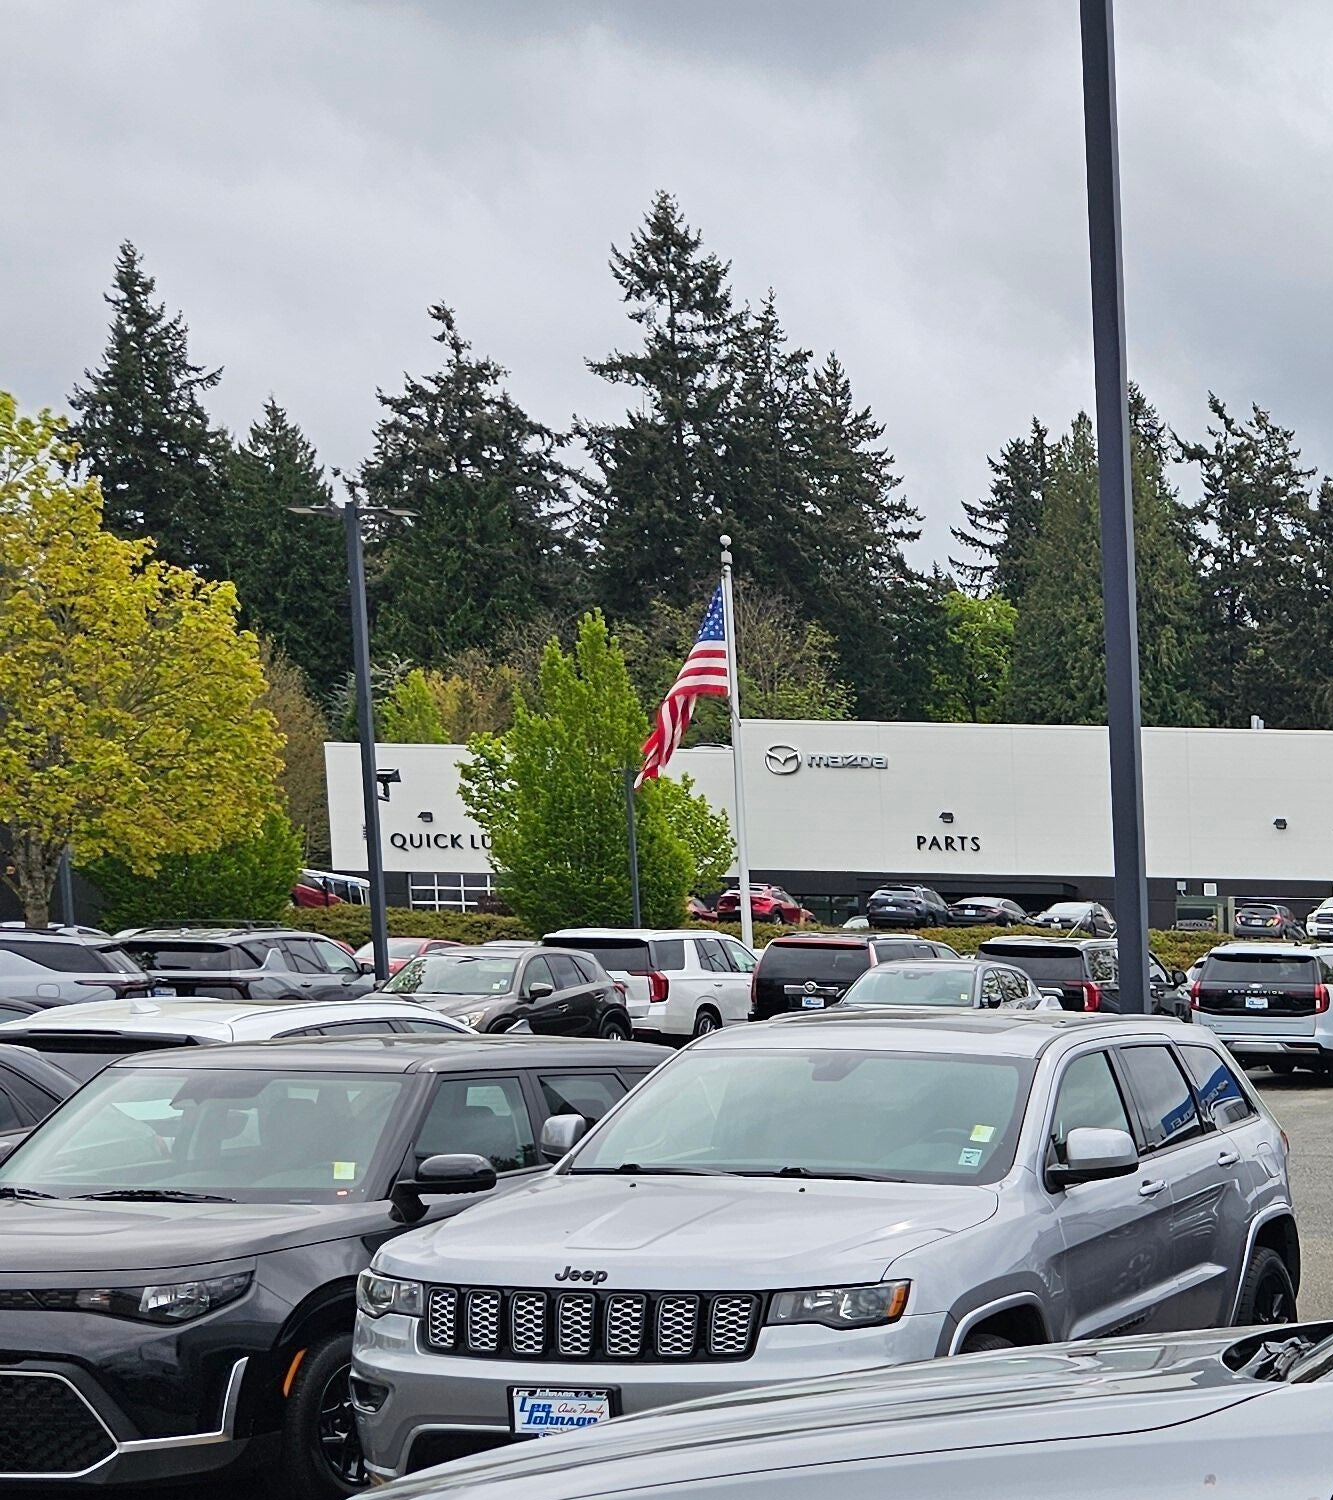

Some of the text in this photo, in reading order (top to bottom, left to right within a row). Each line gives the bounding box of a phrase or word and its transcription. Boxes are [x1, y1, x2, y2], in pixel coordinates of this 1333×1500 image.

[390, 832, 494, 852] QUICK LU
[916, 835, 981, 852] PARTS
[554, 1265, 609, 1286] Jeep
[520, 1397, 553, 1413] Lee
[522, 1407, 598, 1427] Johnson
